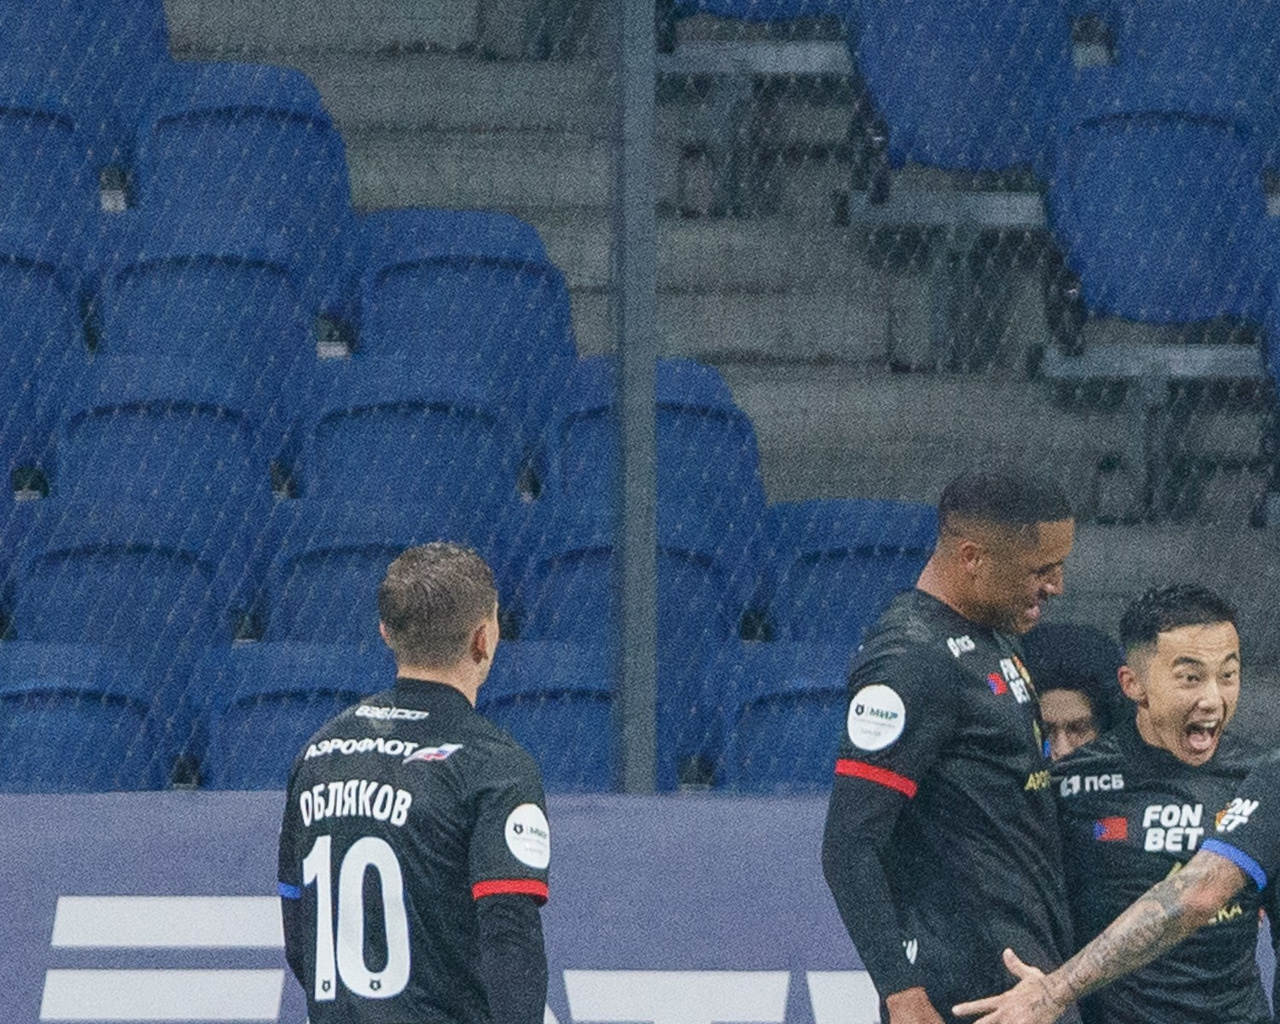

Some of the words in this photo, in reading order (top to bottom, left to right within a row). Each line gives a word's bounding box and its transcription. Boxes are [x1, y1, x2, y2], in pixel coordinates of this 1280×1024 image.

[303, 737, 419, 761] АЭРОФЛОТ
[1084, 773, 1125, 793] ПСБ
[299, 778, 413, 828] ОБЛЯКОВ
[1142, 803, 1203, 828] FON
[1143, 826, 1205, 852] BET
[301, 834, 412, 1002] 10
